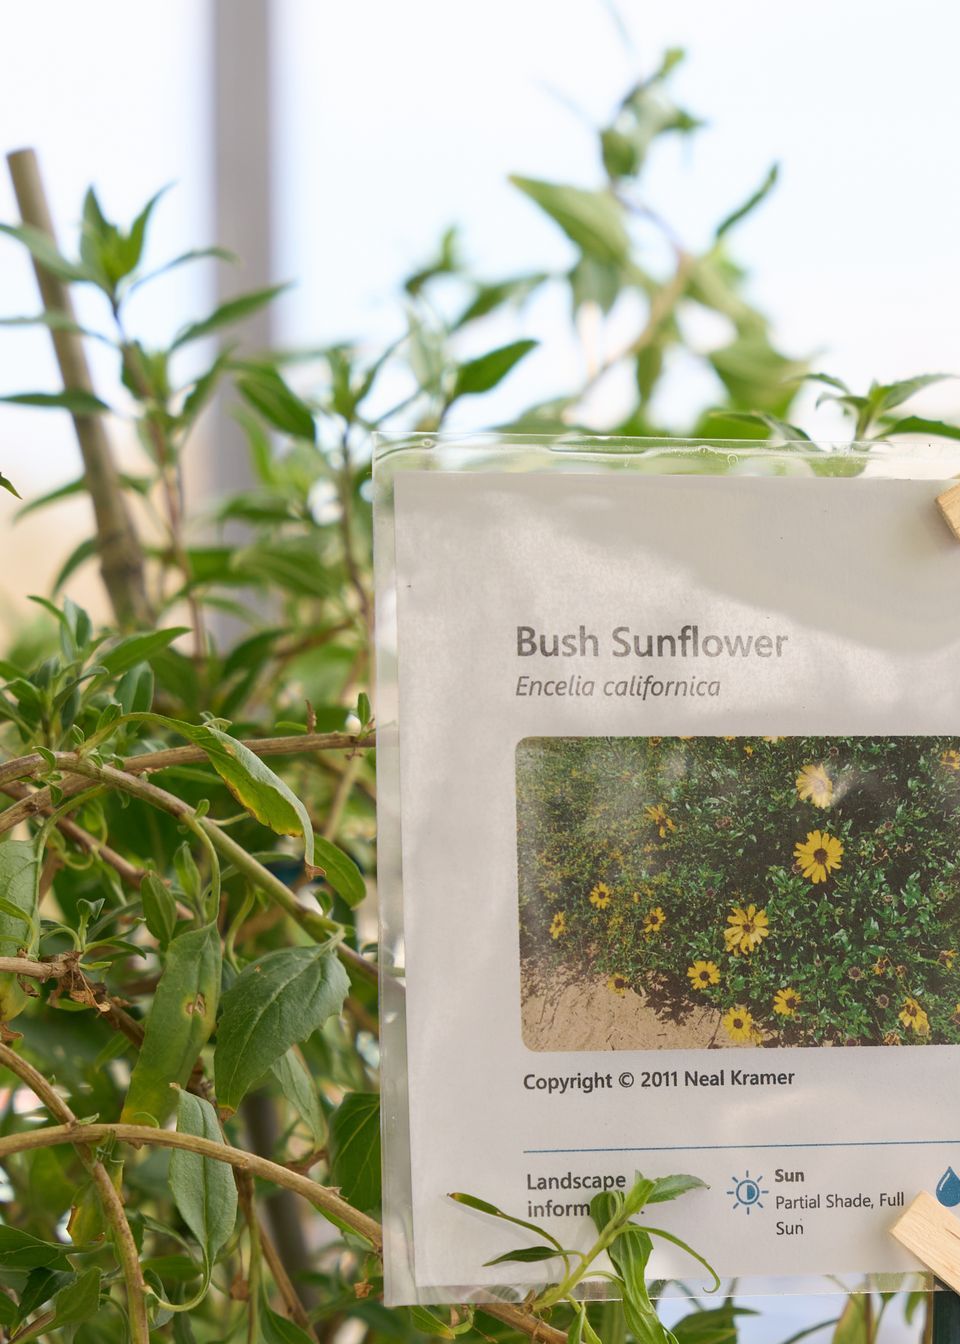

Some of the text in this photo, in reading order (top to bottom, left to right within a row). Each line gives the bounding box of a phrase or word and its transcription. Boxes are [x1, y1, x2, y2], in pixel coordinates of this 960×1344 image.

[516, 626, 788, 658] Bush Sunflower
[516, 675, 720, 700] Encelia californica
[523, 1072, 612, 1093] Copyright
[641, 1072, 677, 1088] 2011
[684, 1070, 725, 1087] Neal
[730, 1070, 795, 1086] Kramer
[527, 1172, 626, 1191] Landscape
[775, 1169, 805, 1182] Sun
[776, 1192, 904, 1209] Partial Shade, Full
[776, 1222, 803, 1235] Sun
